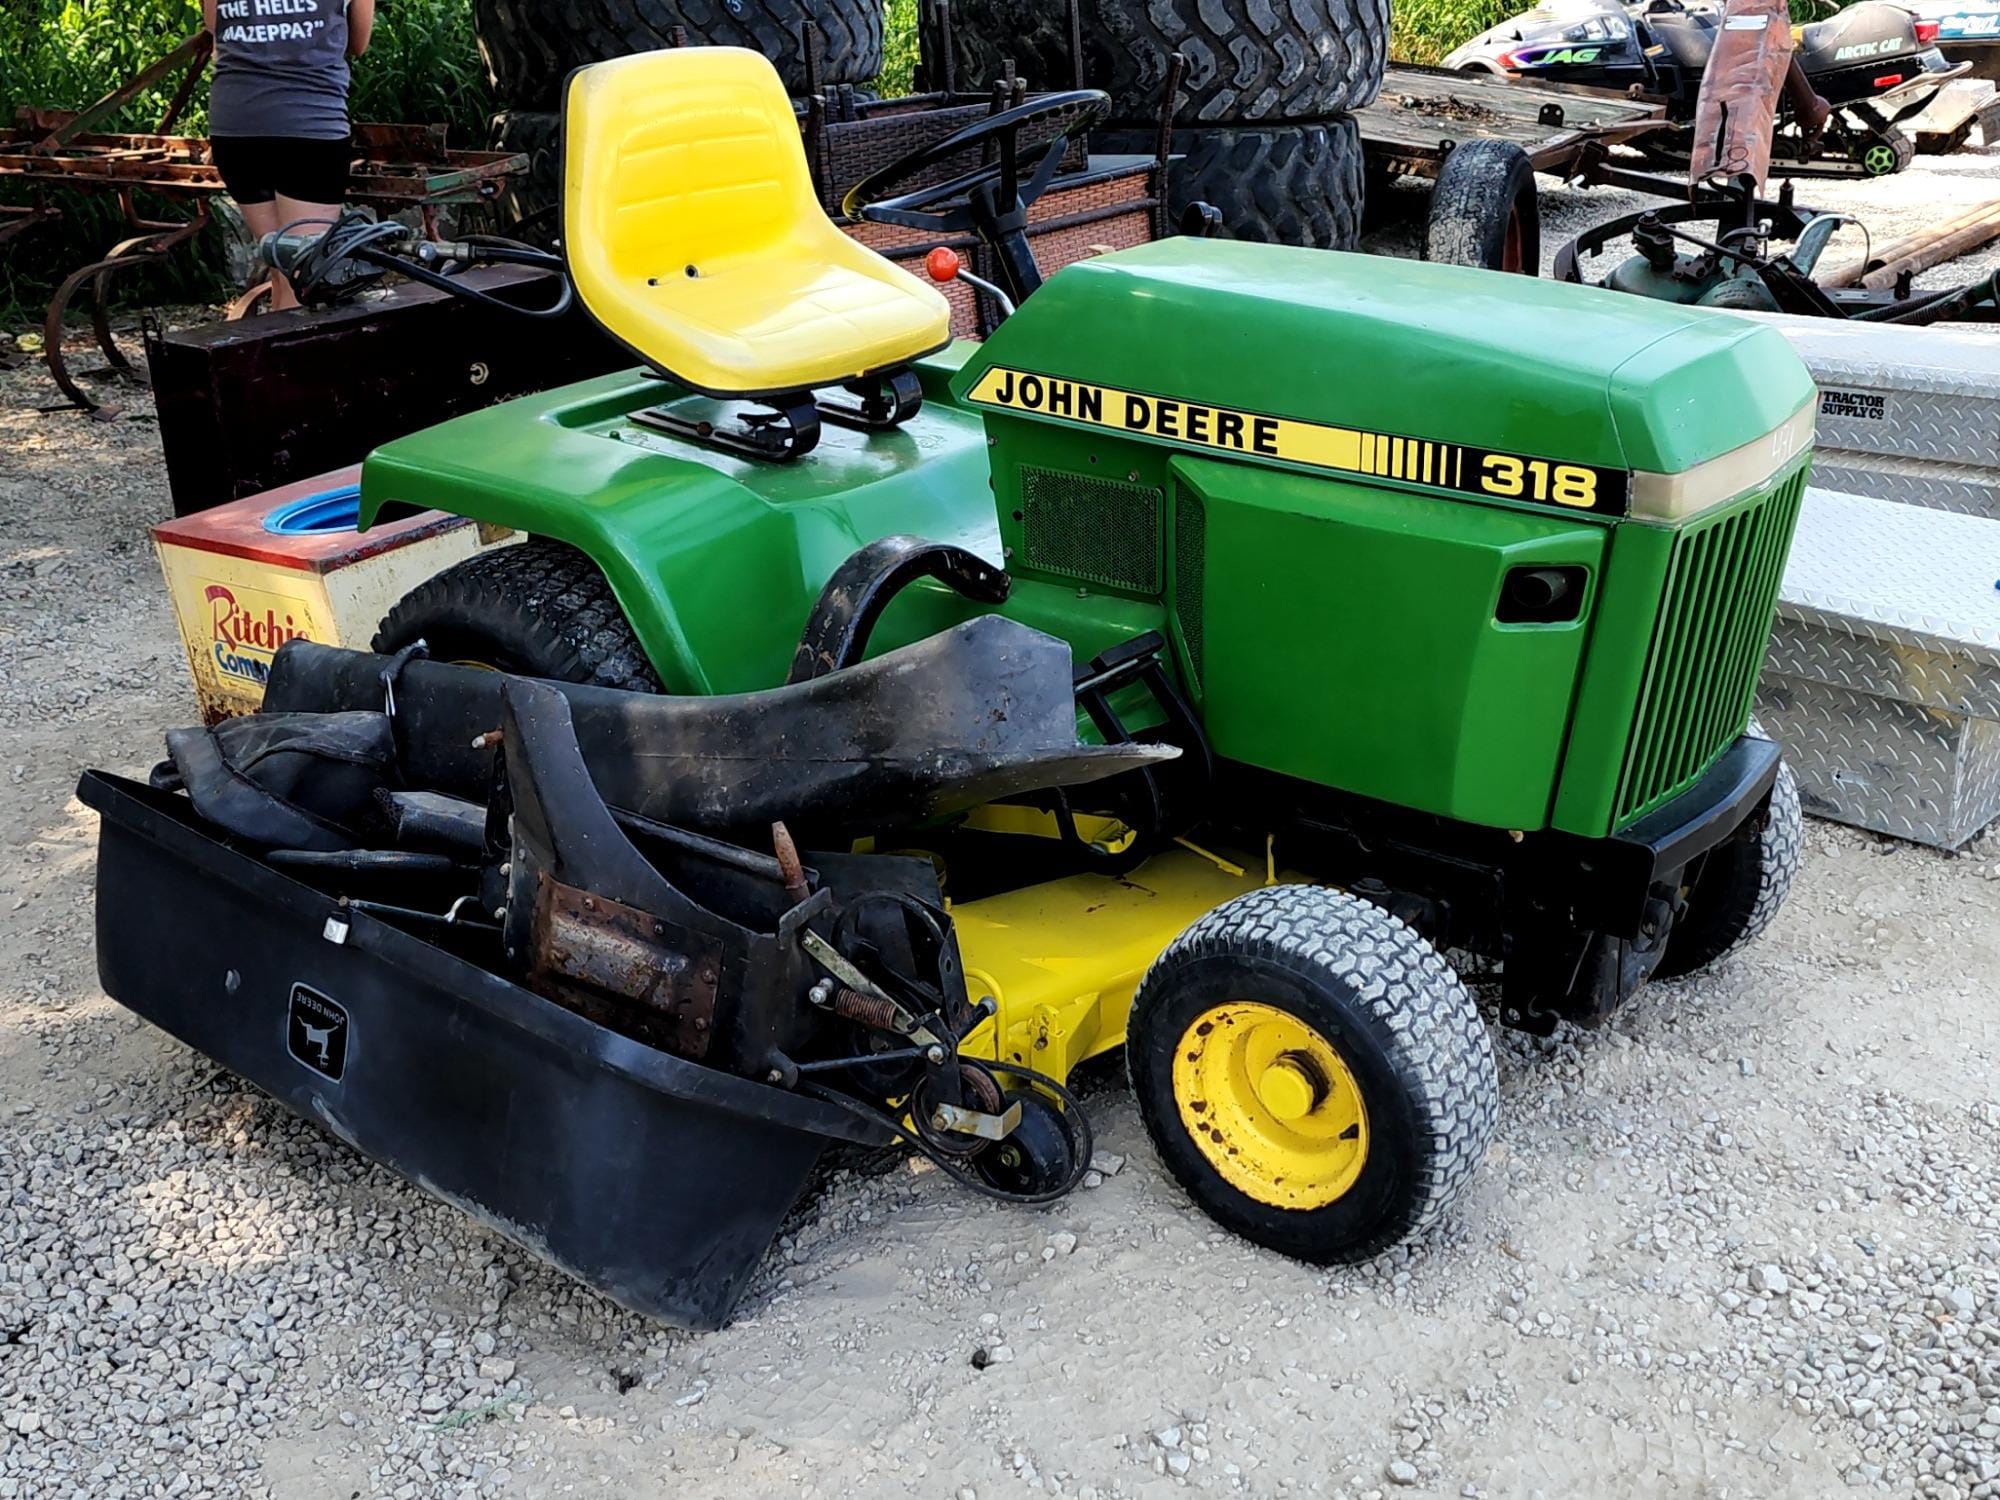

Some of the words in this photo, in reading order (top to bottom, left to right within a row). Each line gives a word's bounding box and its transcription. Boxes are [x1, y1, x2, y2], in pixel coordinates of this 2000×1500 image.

[217, 0, 249, 19] THE
[1531, 48, 1602, 64] JAG
[1834, 41, 1878, 60] ARCTIC
[1880, 37, 1903, 53] CAT
[1823, 391, 1885, 408] TRACTOR
[995, 372, 1102, 421] JOHN
[1125, 395, 1278, 454] DEERE
[1821, 403, 1868, 418] SUPPLY
[1481, 454, 1597, 507] 318
[296, 992, 322, 1013] DEERE
[323, 1007, 345, 1025] JOHN
